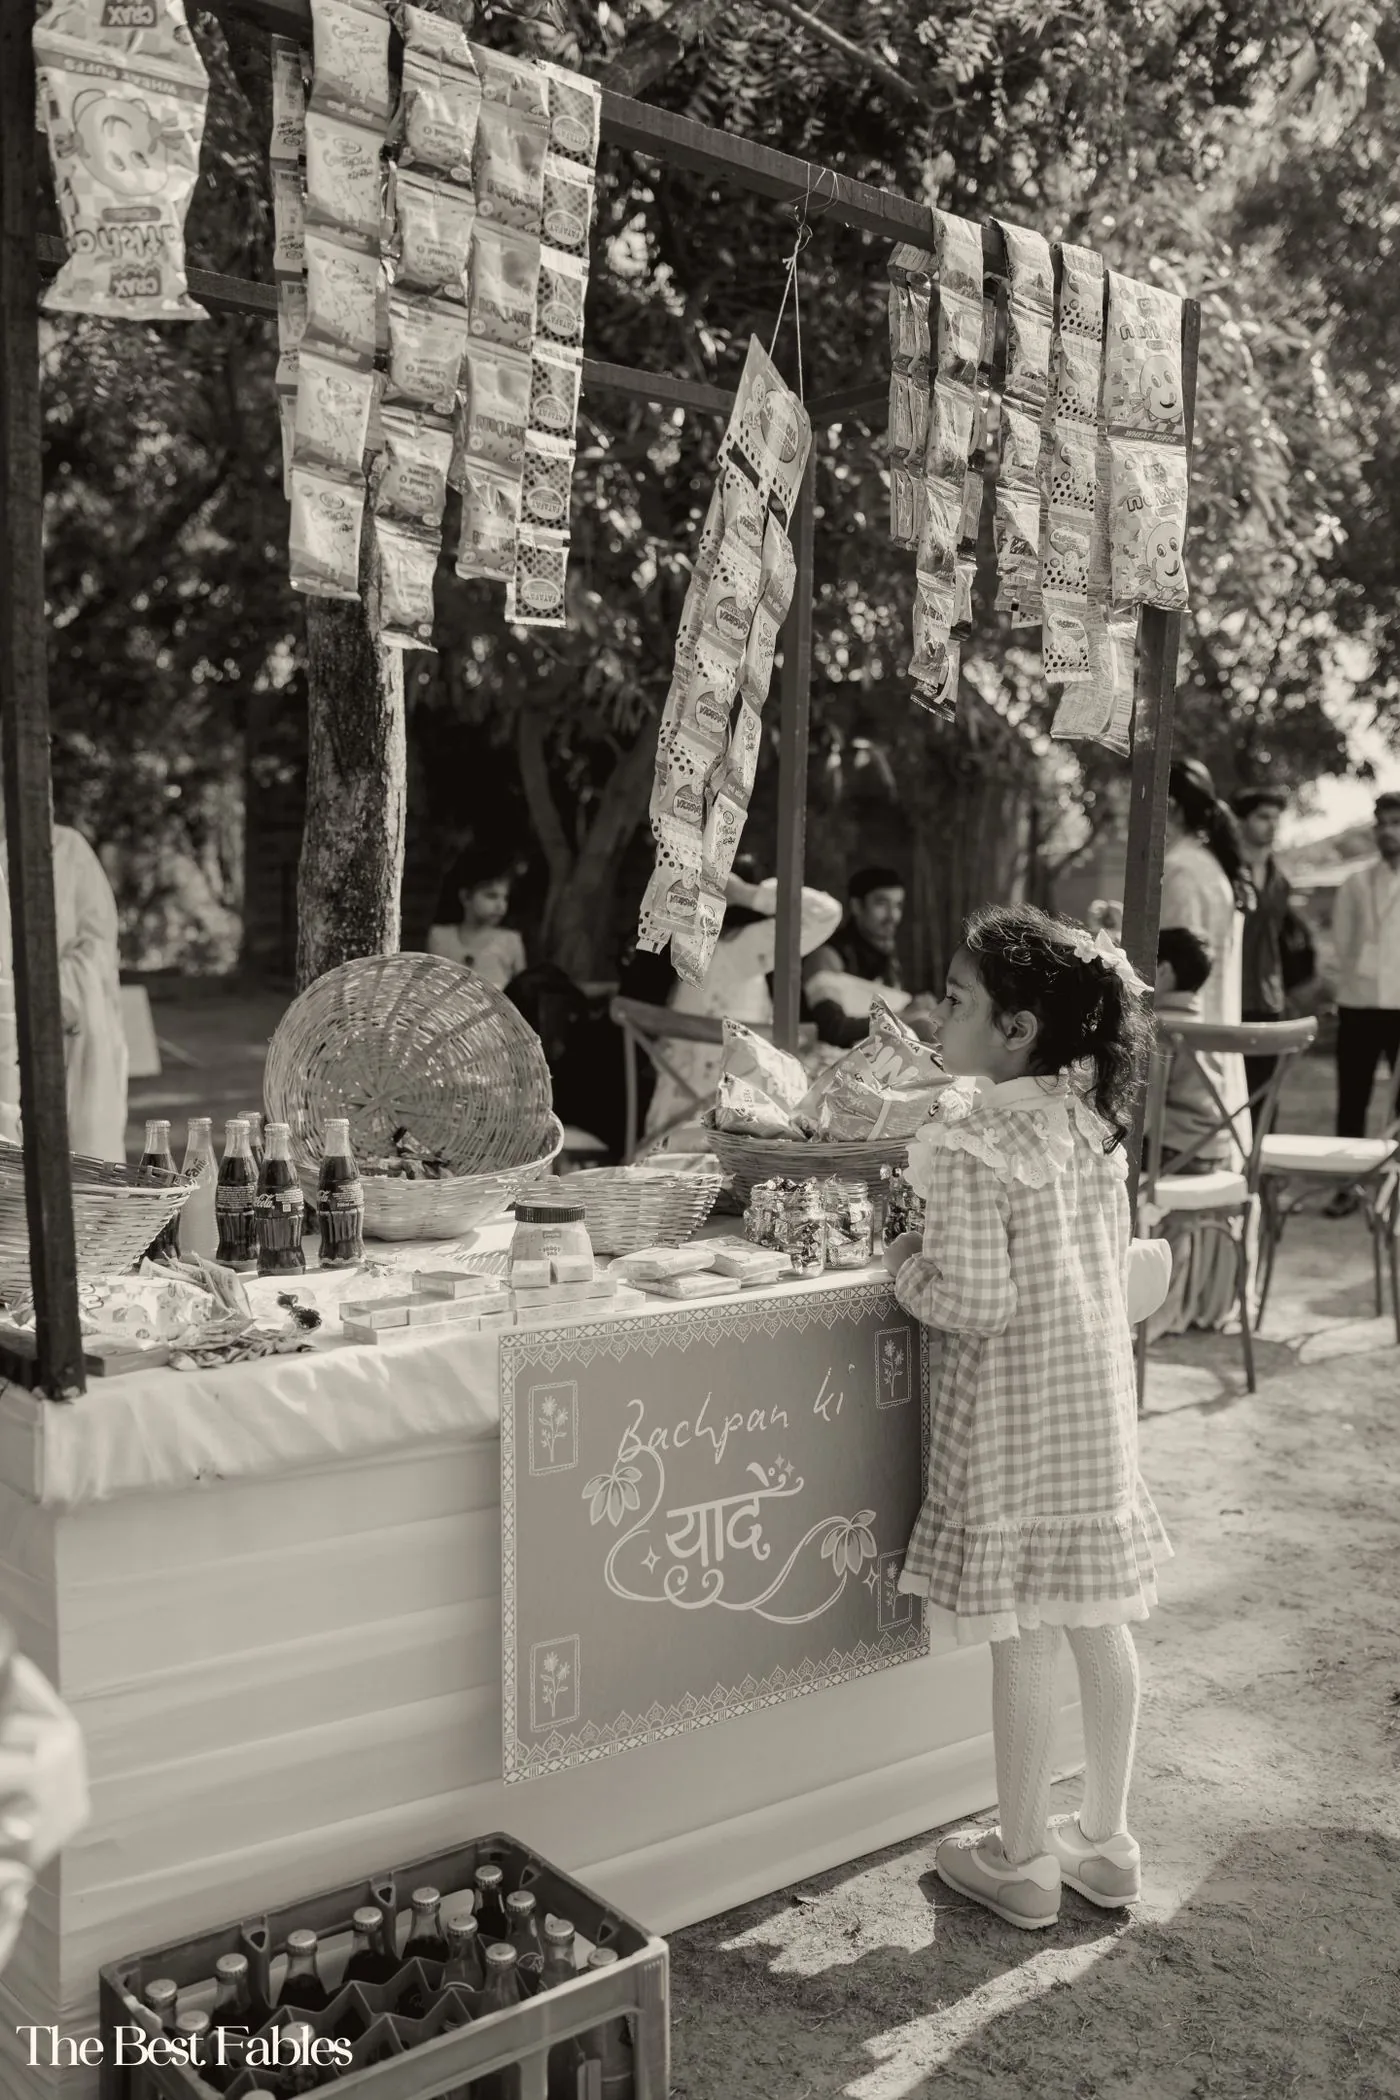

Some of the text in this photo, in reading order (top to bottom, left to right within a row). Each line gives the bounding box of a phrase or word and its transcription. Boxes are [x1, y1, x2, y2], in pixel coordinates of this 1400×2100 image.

[107, 4, 154, 25] CRAX
[62, 57, 178, 96] WHEAT PUFFS
[113, 276, 158, 296] CRAX
[1124, 429, 1179, 443] WHEAT PUFFS
[526, 590, 556, 603] FATAFAT
[616, 1362, 855, 1465] Bachpan ki
